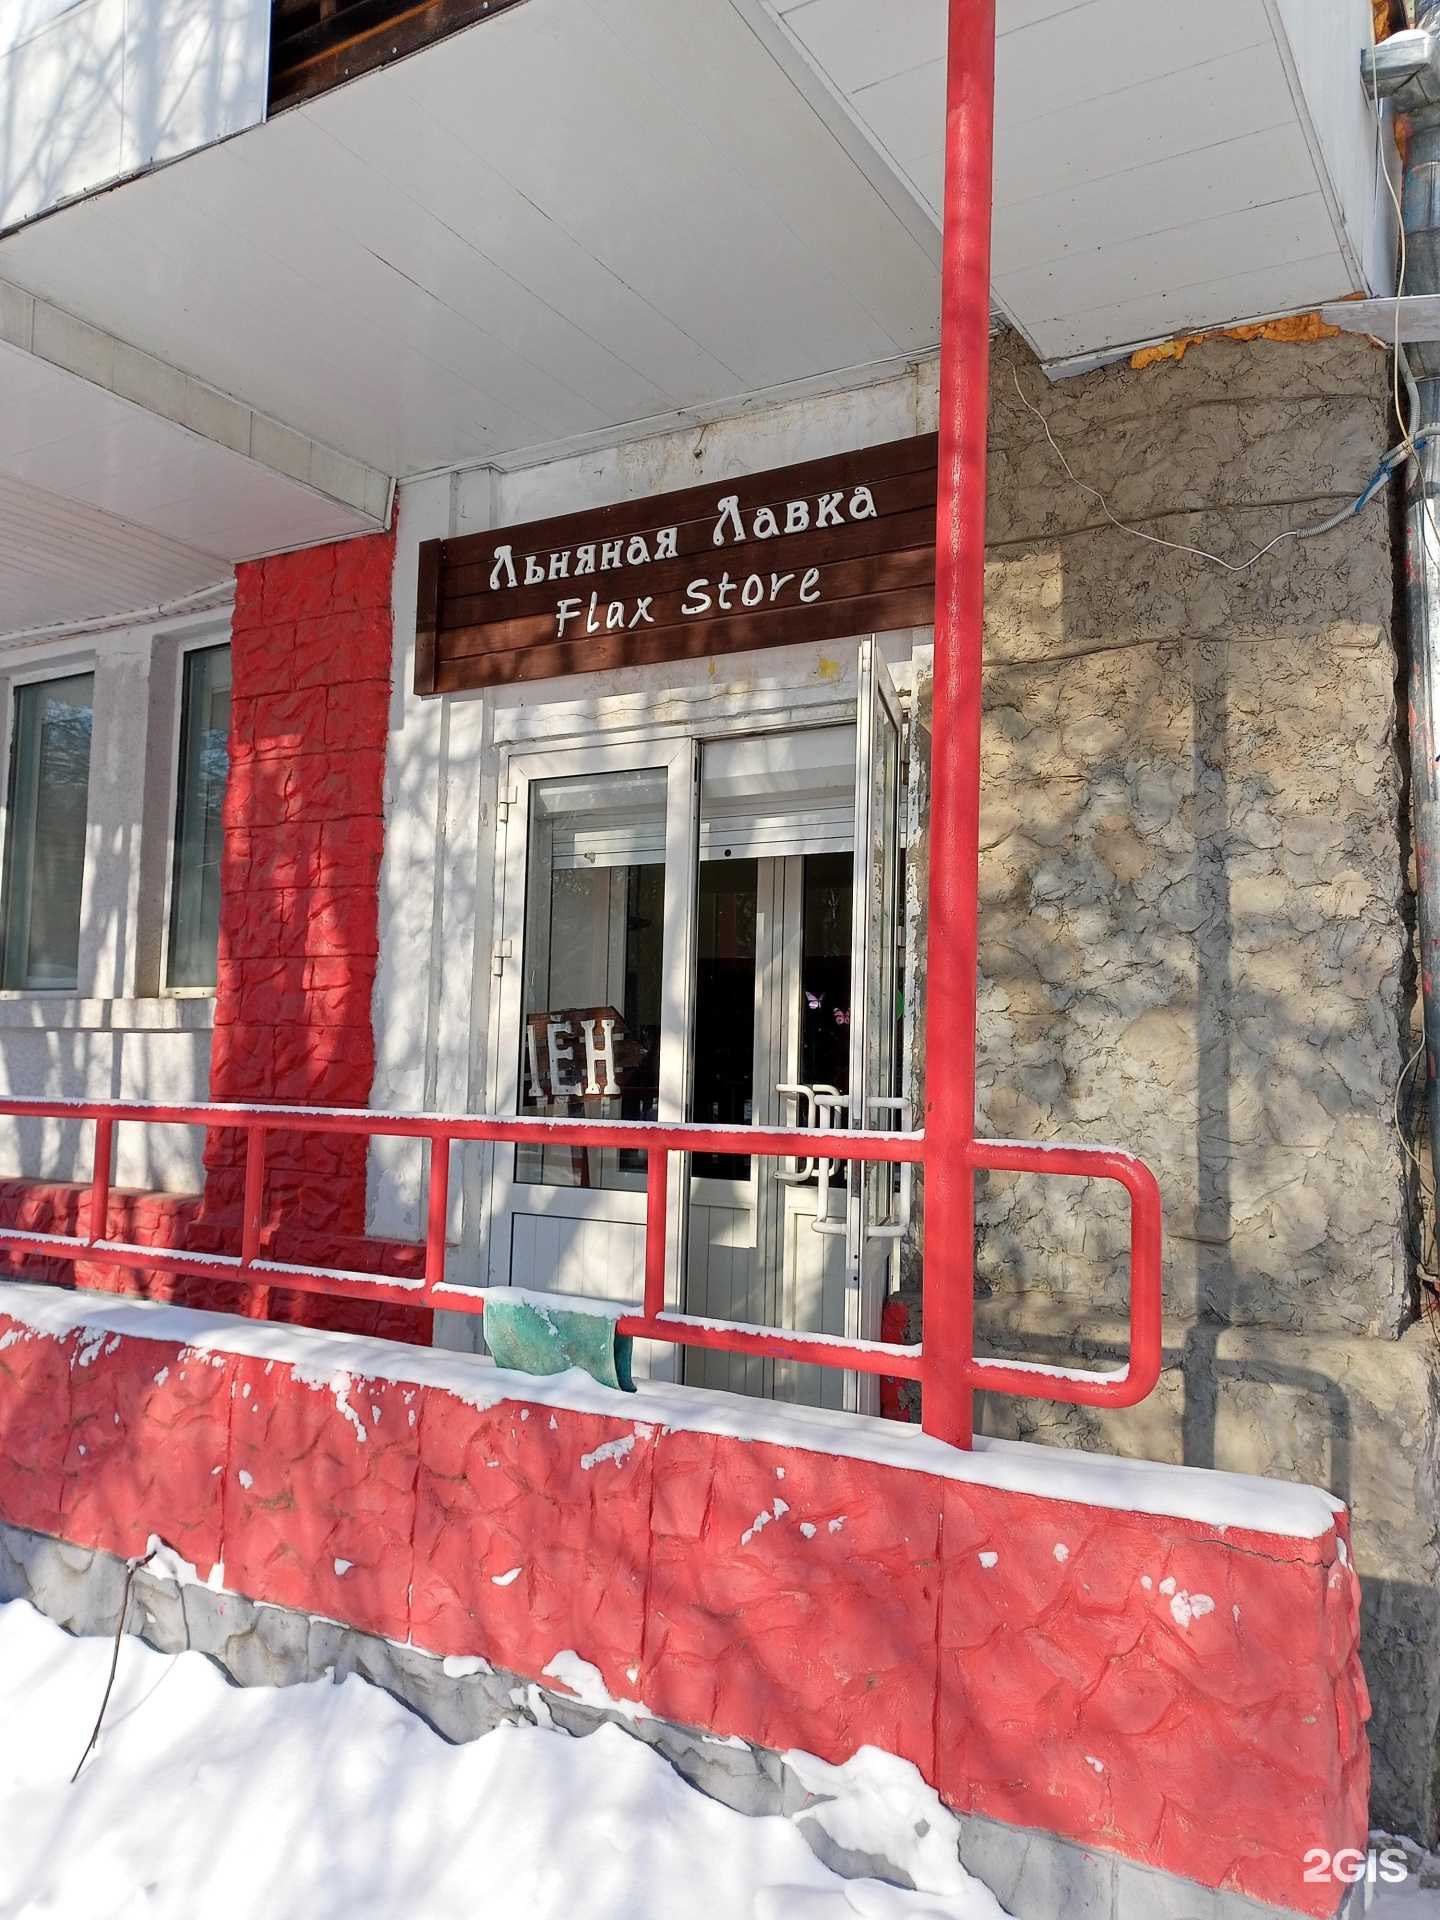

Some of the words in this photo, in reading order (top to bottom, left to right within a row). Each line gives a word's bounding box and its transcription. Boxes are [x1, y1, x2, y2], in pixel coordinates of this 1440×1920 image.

[489, 529, 679, 590] Льняная
[713, 486, 878, 546] Лавка
[555, 591, 655, 638] Flax
[681, 567, 821, 615] Store
